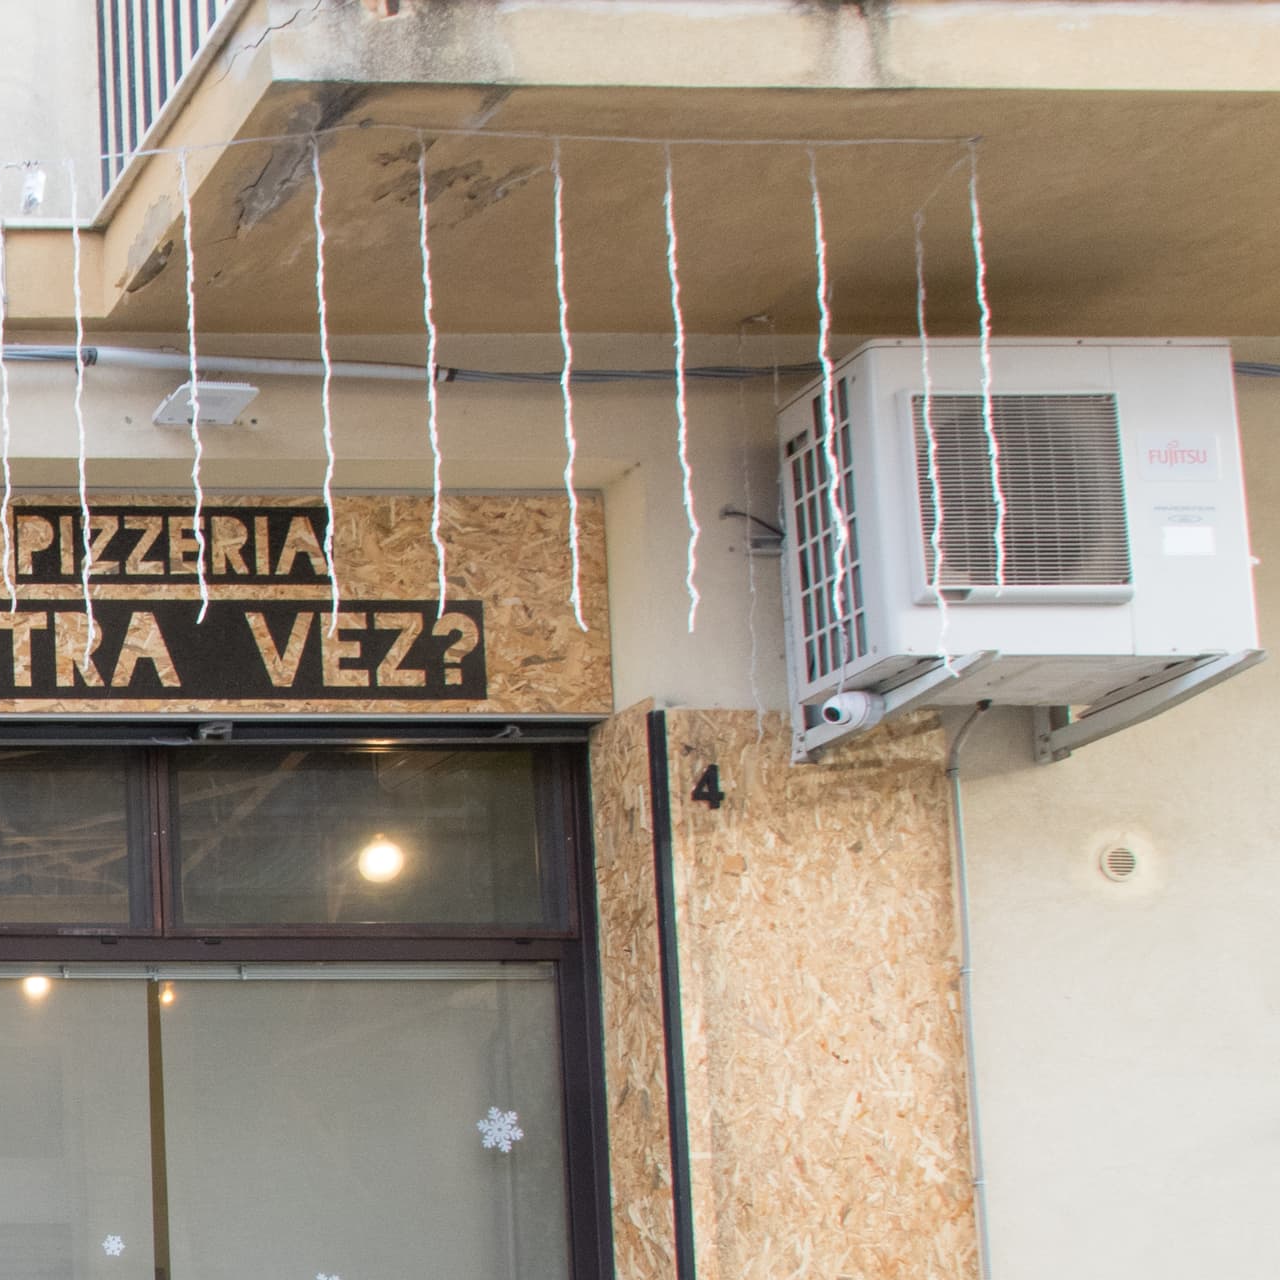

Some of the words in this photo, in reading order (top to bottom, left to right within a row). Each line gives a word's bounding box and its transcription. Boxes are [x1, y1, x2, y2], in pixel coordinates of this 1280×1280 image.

[1148, 443, 1208, 467] FUJITSU
[15, 514, 331, 576] PIZZERIA
[244, 612, 480, 688] VEZ?
[691, 764, 725, 809] 4
